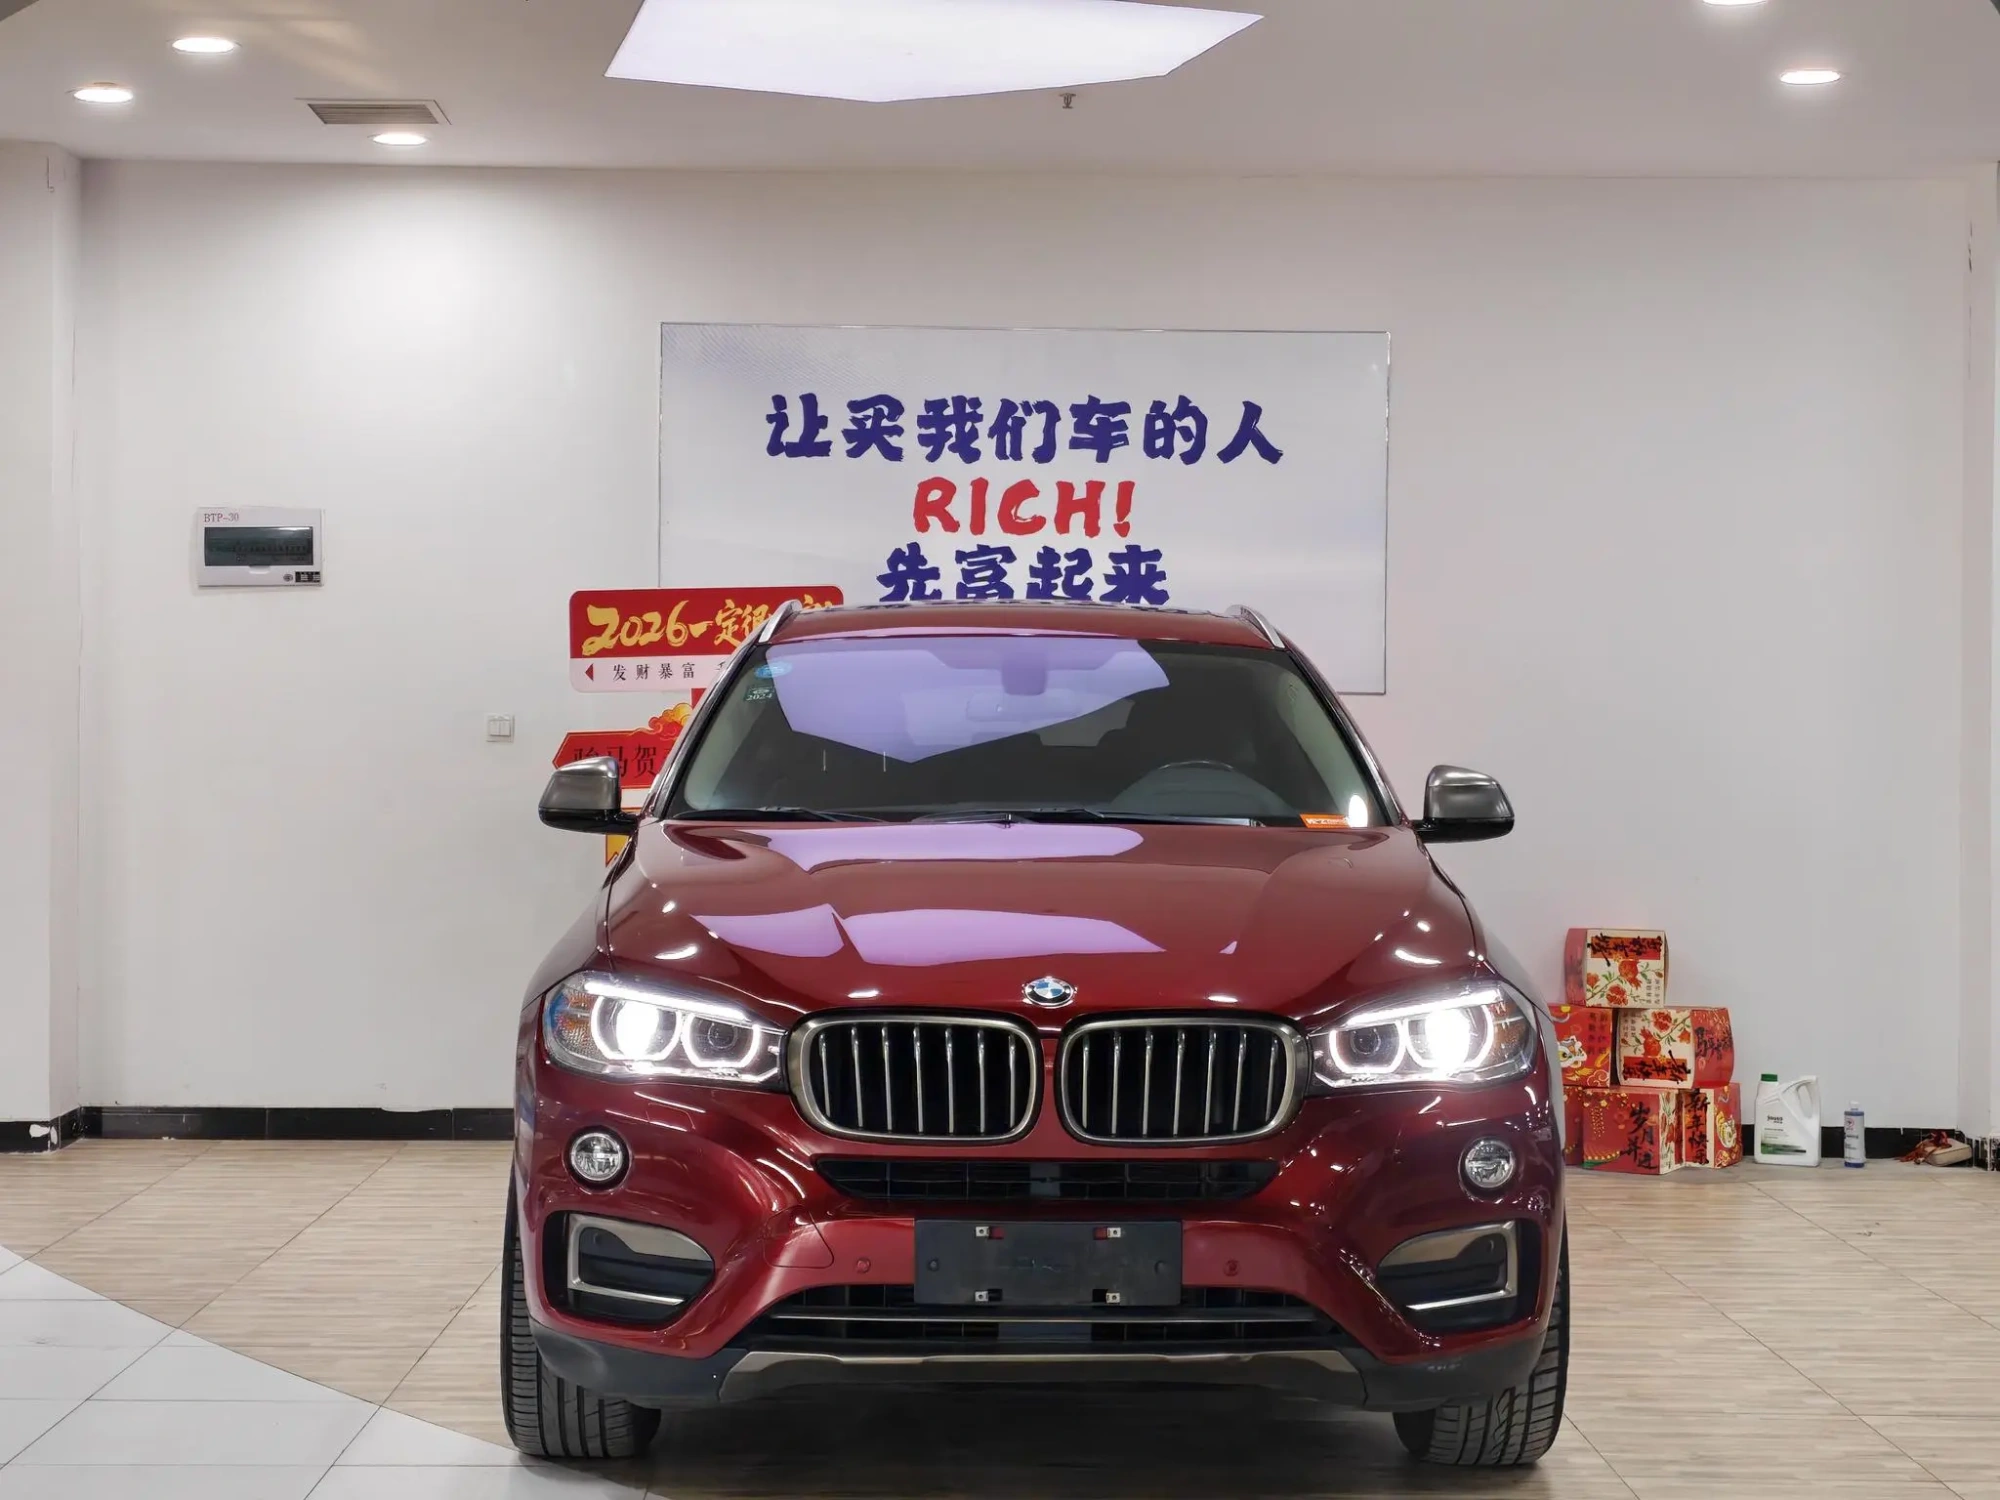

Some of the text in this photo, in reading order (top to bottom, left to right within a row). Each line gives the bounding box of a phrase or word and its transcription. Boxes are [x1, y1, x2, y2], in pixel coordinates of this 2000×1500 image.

[766, 393, 1283, 466] 让买我们车的人
[204, 512, 239, 522] BTP-30
[913, 476, 1135, 538] RICH!
[877, 542, 1170, 604] 先富起来
[612, 662, 696, 681] 发财暴富
